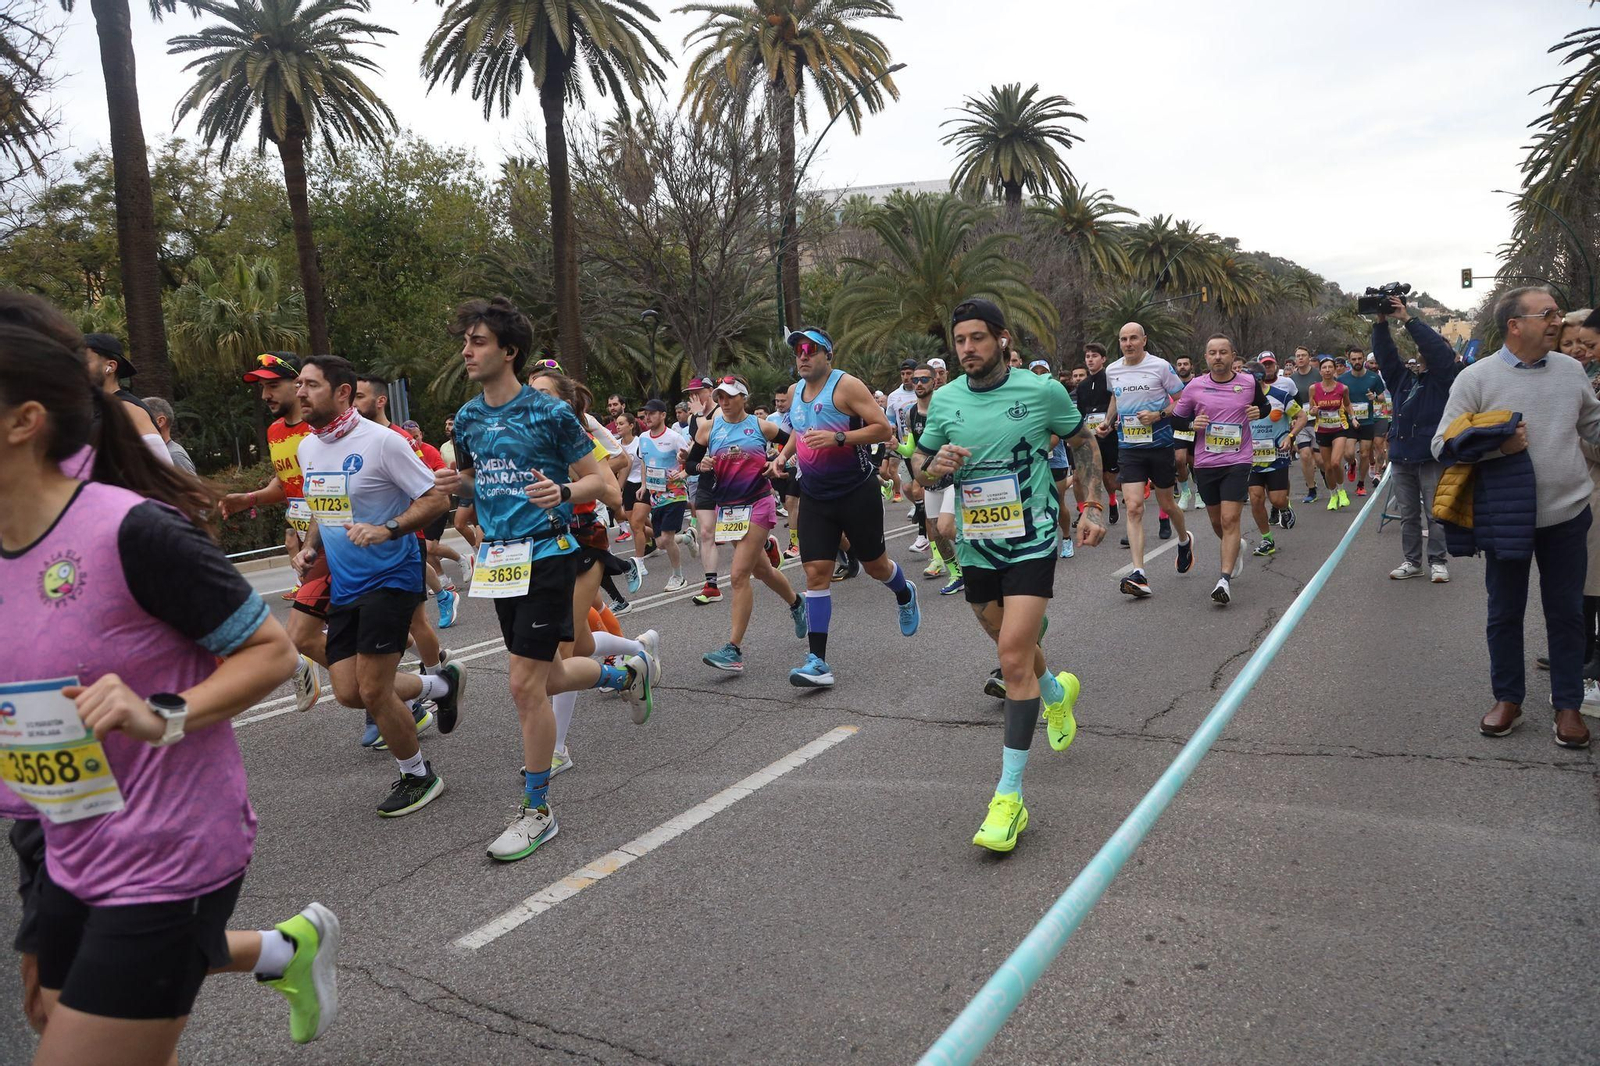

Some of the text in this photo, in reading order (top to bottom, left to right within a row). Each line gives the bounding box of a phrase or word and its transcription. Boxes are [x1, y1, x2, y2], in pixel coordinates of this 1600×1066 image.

[1122, 384, 1150, 392] FIDIAS
[1127, 427, 1147, 436] 1773
[1212, 437, 1236, 446] 1789
[274, 458, 294, 472] SIA
[480, 458, 517, 472] MEDIA
[486, 467, 544, 485] MARATÓ
[313, 498, 342, 512] 1723
[969, 505, 1011, 525] 2350
[722, 522, 744, 532] 3220
[487, 565, 522, 583] 3636
[8, 750, 81, 785] 3568
